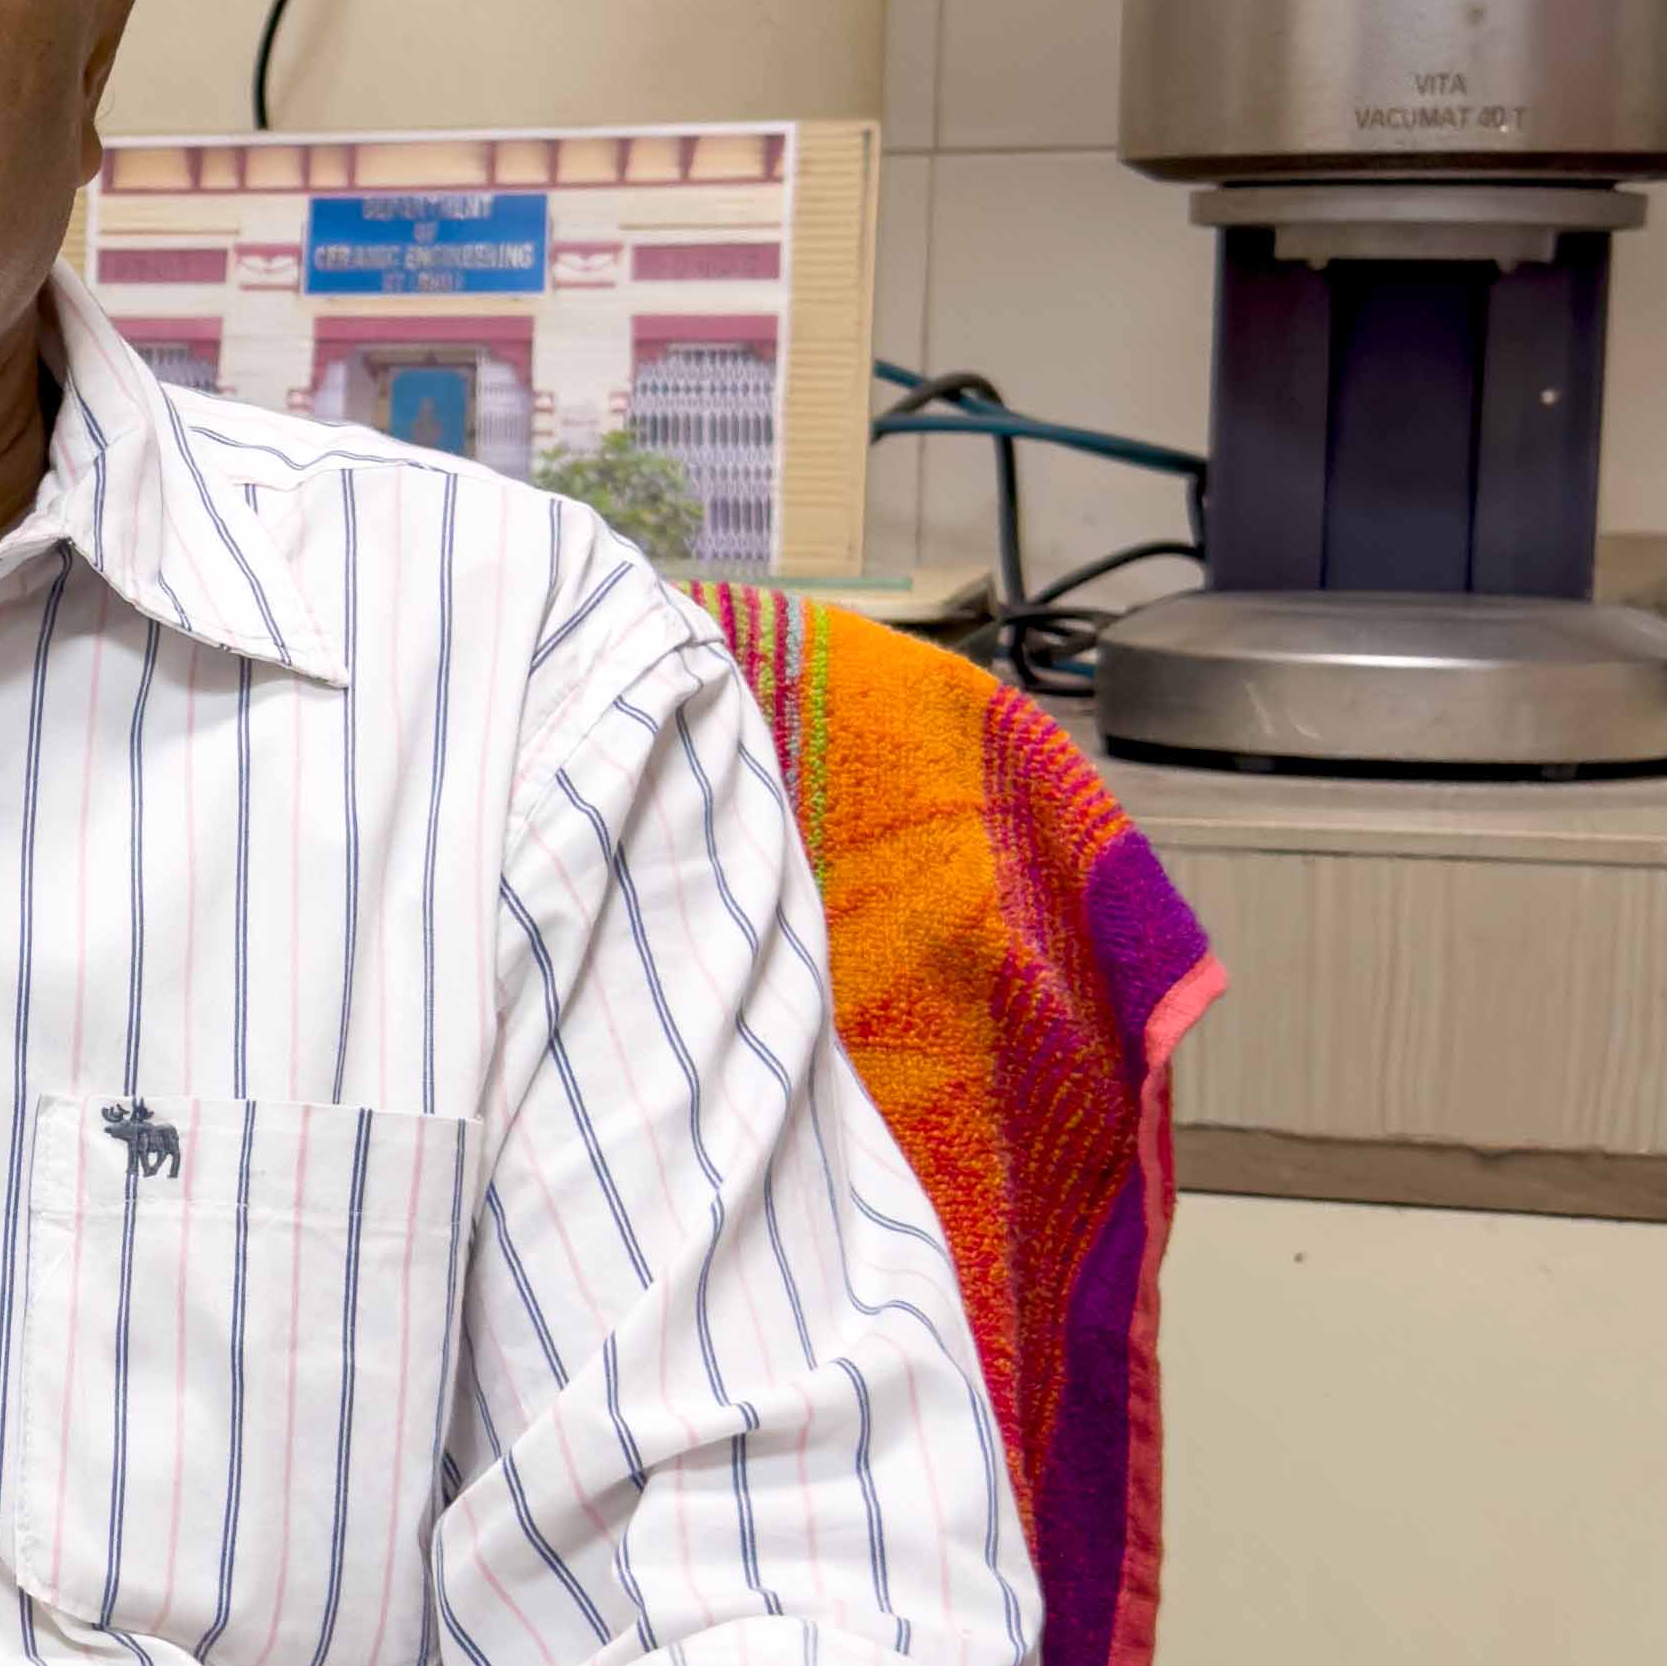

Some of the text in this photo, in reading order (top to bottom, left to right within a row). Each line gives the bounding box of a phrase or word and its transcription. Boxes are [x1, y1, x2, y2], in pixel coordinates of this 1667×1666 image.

[1415, 72, 1467, 96] VITA
[1355, 106, 1471, 130] VACUMAT
[362, 195, 493, 220] DEPARTMENT
